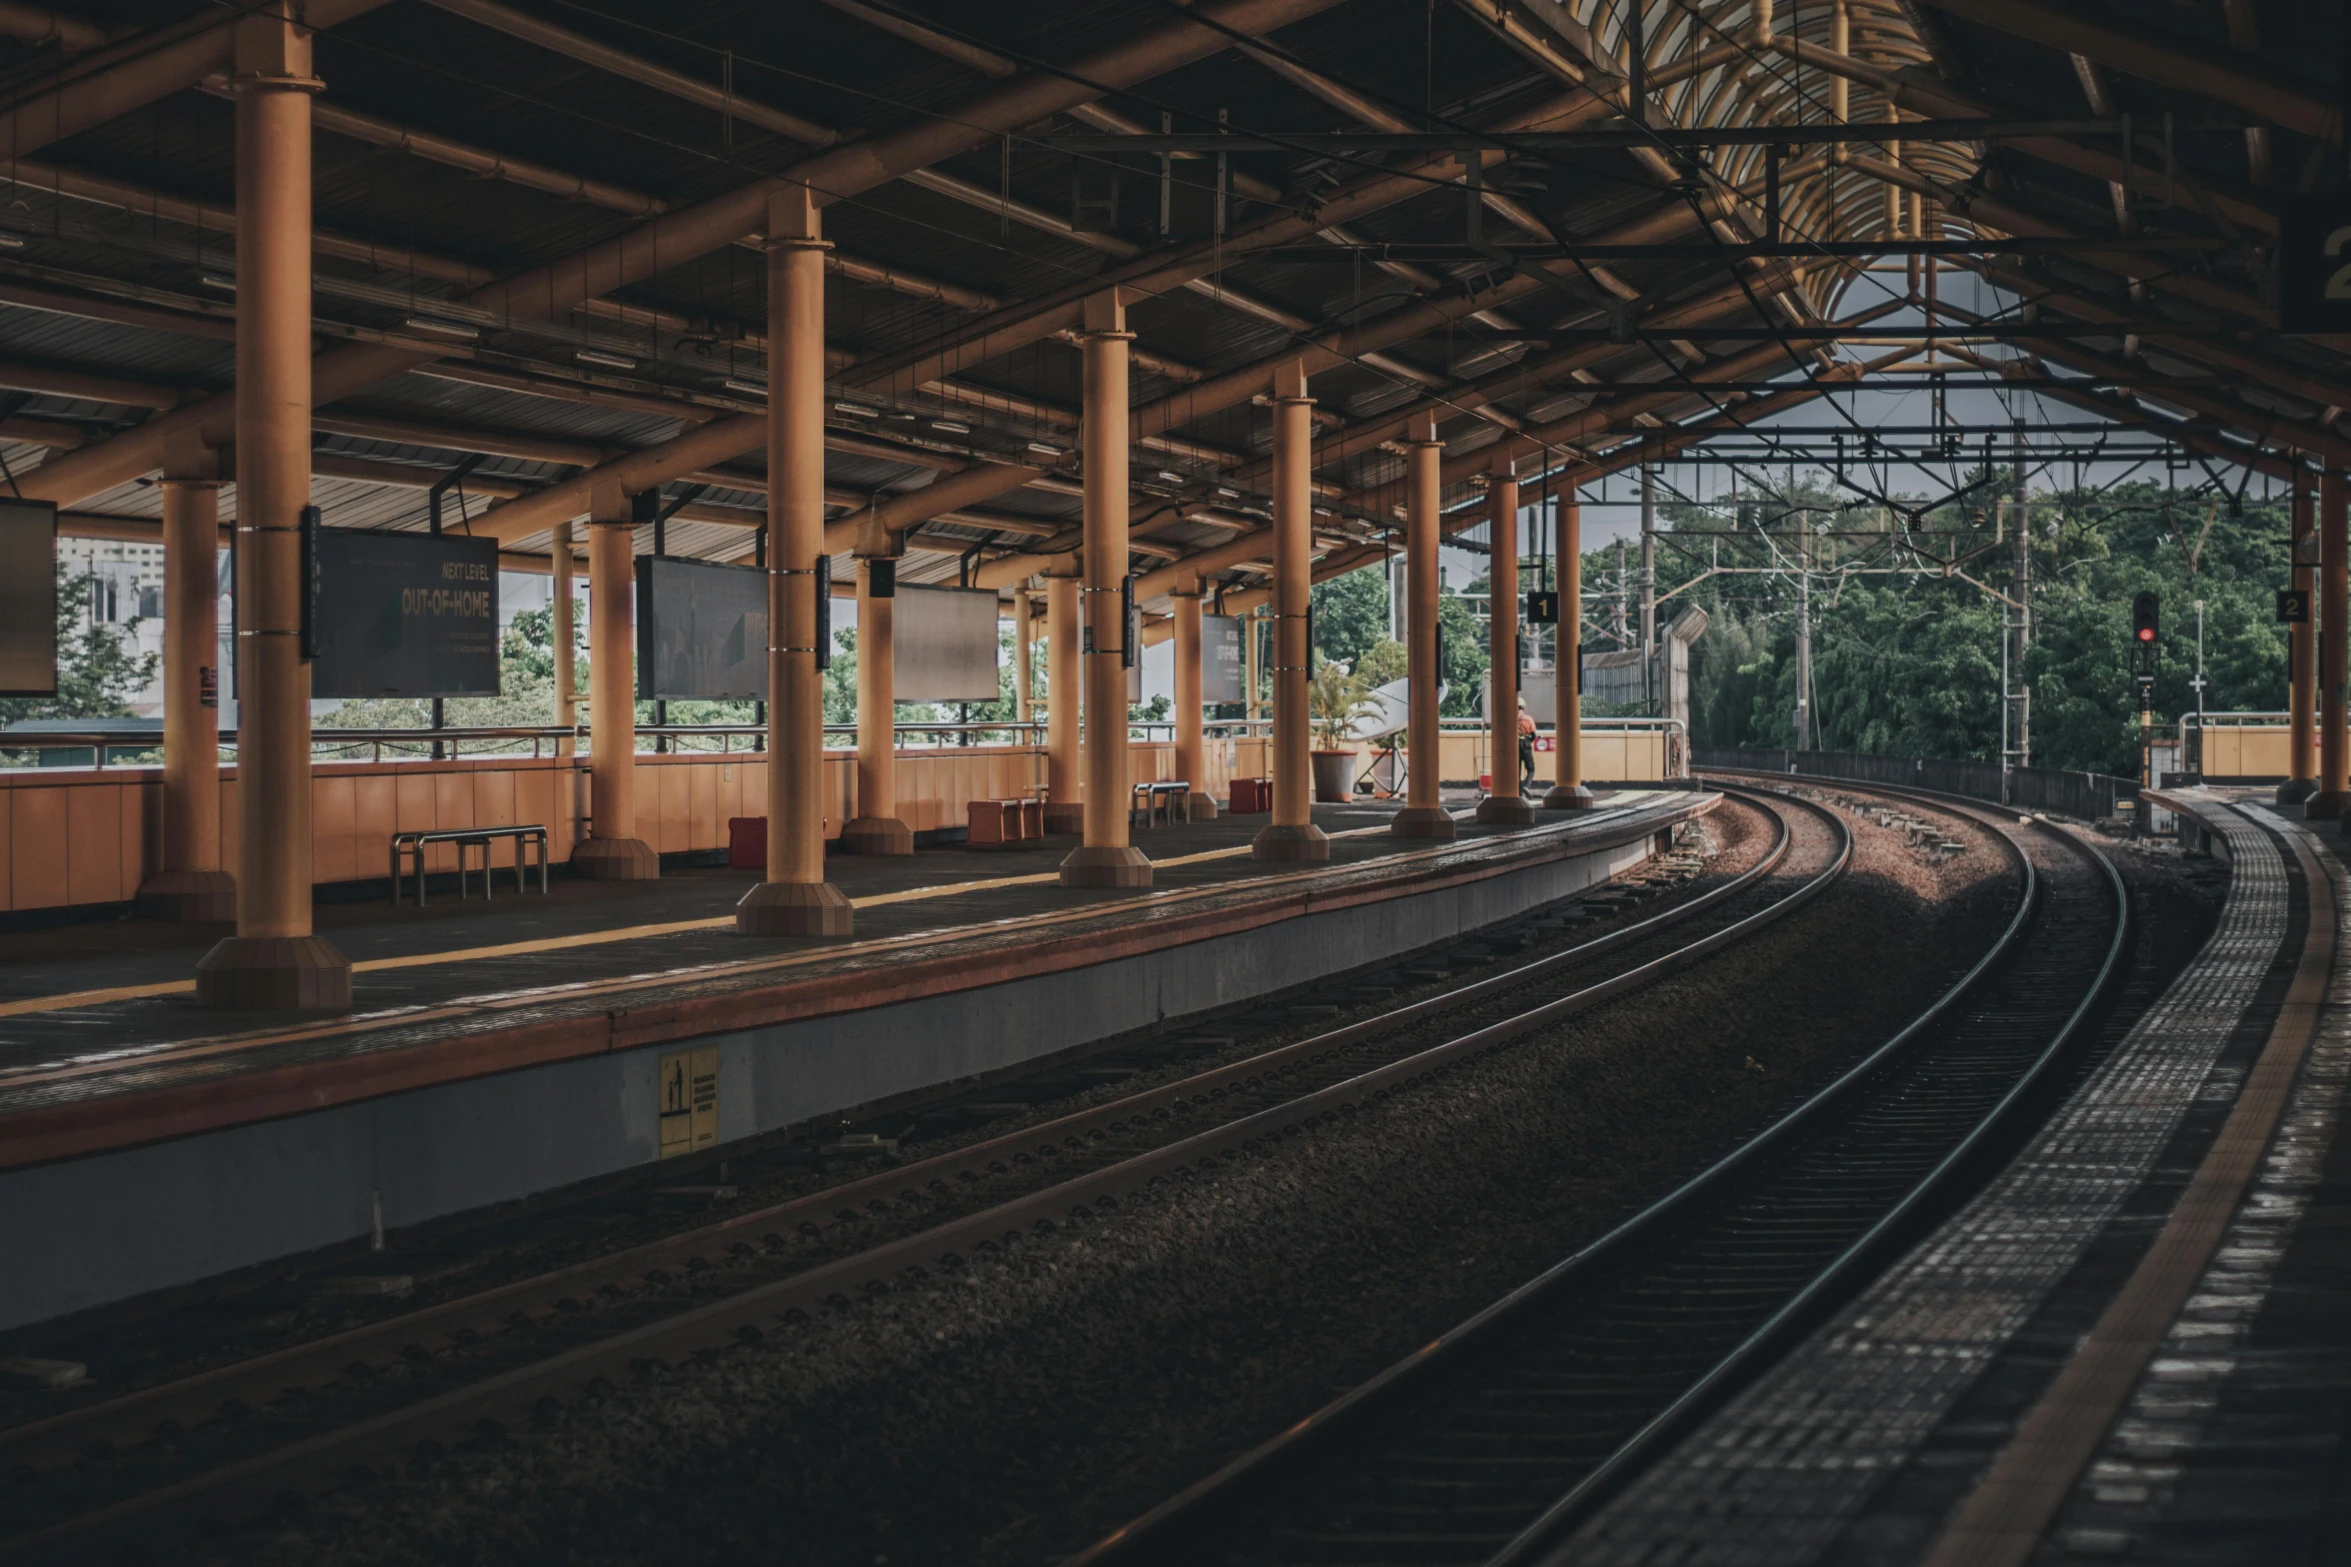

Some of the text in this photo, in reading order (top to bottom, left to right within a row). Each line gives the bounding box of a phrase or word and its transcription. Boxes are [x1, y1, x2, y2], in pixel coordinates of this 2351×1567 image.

[2324, 225, 2351, 299] 2
[442, 562, 490, 581] NEXT LEVEL
[402, 588, 490, 617] OUT-OF-HOME
[1538, 599, 1547, 616] 1
[2286, 598, 2299, 615] 2
